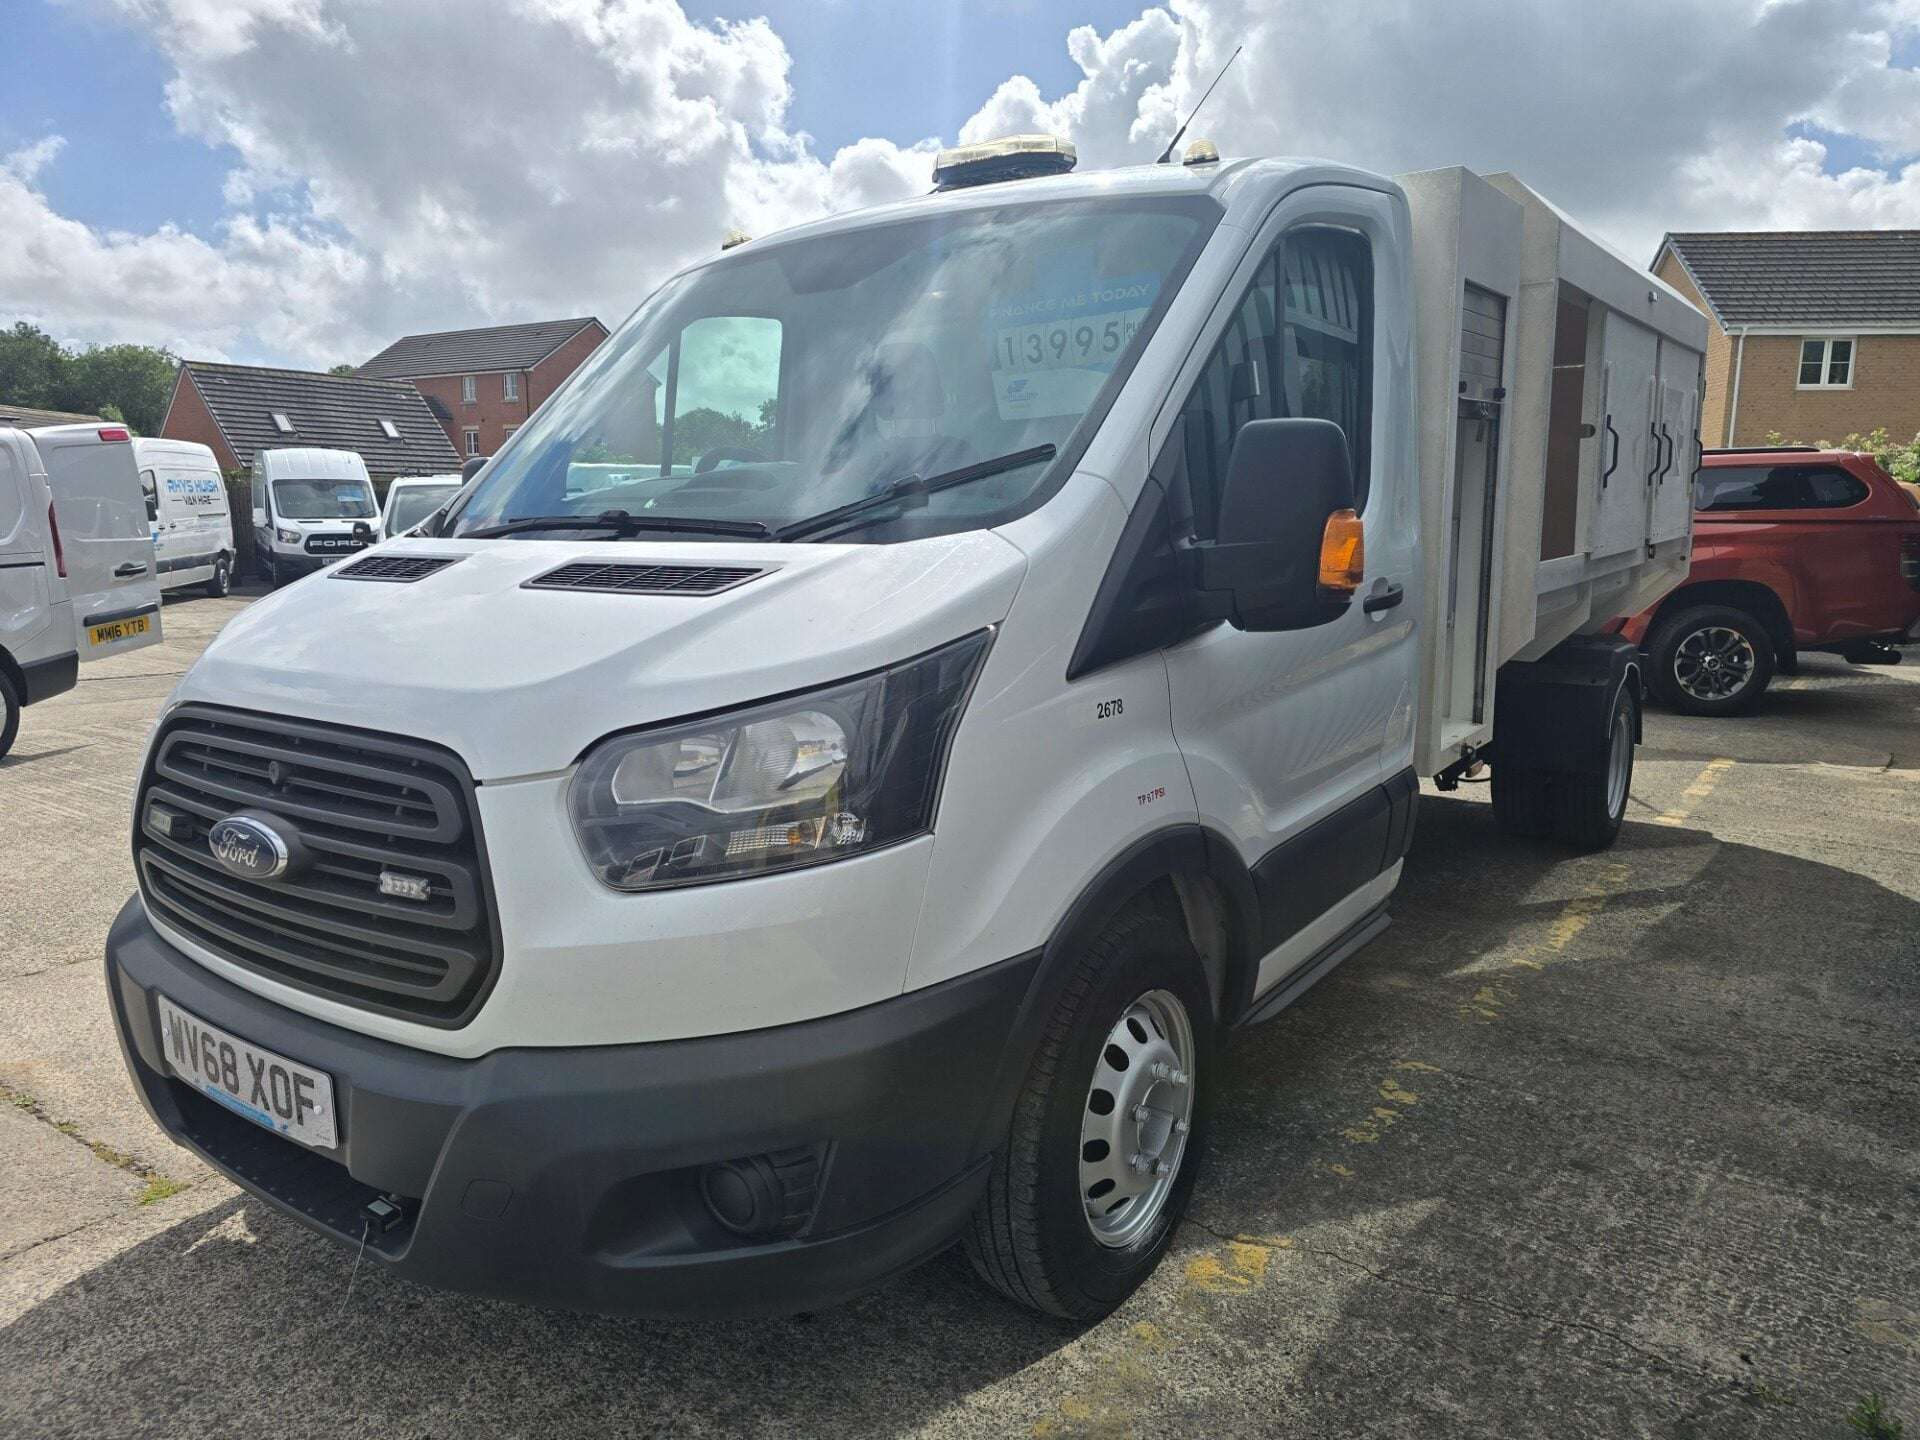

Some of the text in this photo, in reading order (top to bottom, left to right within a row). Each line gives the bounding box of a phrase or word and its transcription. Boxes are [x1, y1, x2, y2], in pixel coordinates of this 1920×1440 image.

[1090, 283, 1150, 304] TODAY
[1005, 320, 1120, 367] 13995
[167, 479, 194, 492] RHYS
[182, 495, 212, 505] VAN HIRE
[96, 619, 145, 642] MM16 YTB
[1097, 698, 1123, 719] 2678
[219, 827, 260, 868] Ford
[168, 1010, 240, 1095] WV68
[246, 1052, 315, 1126] XOF
